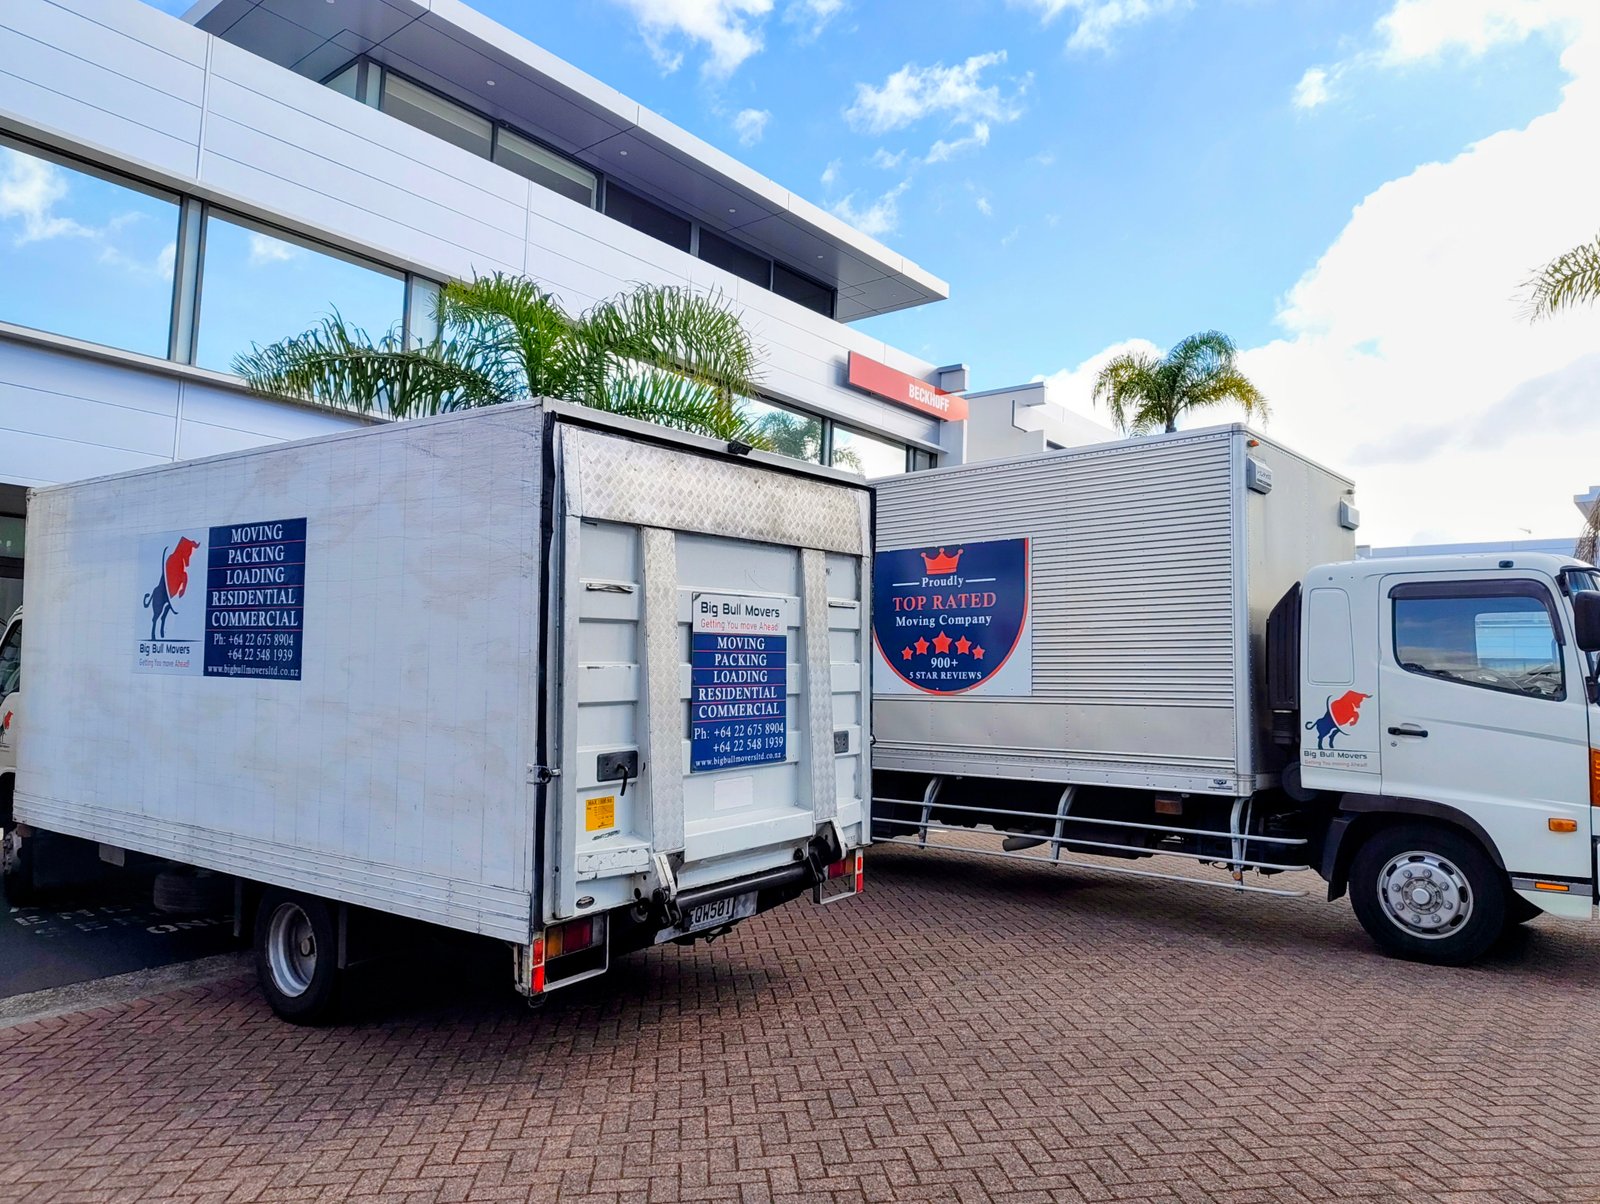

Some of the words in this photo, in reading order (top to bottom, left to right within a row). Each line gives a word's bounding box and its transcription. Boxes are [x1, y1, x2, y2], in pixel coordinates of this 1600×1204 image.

[909, 384, 950, 412] BECKHOFF
[231, 524, 283, 544] MOVING
[228, 545, 284, 564] PACKING
[226, 567, 285, 585] LOADING
[922, 575, 964, 588] Proudly
[212, 588, 296, 606] RESIDENTIAL
[892, 596, 927, 612] TOP
[933, 592, 996, 610] RATED
[701, 601, 718, 617] Big
[723, 603, 741, 615] Bull
[746, 605, 780, 618] Movers
[211, 610, 298, 627] COMMERCIAL
[701, 618, 725, 631] Getting
[727, 620, 738, 629] You
[740, 622, 757, 630] move
[896, 616, 936, 628] Moving
[939, 615, 992, 626] Company
[213, 633, 226, 645] Ph:
[228, 634, 243, 645] +64
[244, 634, 254, 645] 22
[257, 634, 271, 646] 675
[274, 634, 294, 646] 8904
[717, 637, 765, 650] MOVING
[140, 644, 150, 656] Big
[152, 644, 164, 653] Bull
[166, 644, 190, 654] Movers
[227, 649, 242, 660] +64
[243, 649, 254, 660] 22
[256, 649, 270, 661] 548
[273, 649, 292, 661] 1939
[715, 654, 767, 666] PACKING
[931, 657, 958, 669] 900+
[208, 664, 298, 677] www.bigbullmoversltd.co.nz
[713, 670, 768, 683] LOADING
[699, 686, 777, 701] RESIDENTIAL
[699, 702, 779, 718] COMMERCIAL
[694, 727, 709, 740] Ph:
[714, 725, 731, 738] +64
[734, 724, 744, 737] 22
[747, 723, 762, 736] 675
[765, 722, 784, 734] 8904
[713, 740, 730, 753] +64
[733, 740, 744, 752] 22
[747, 738, 762, 750] 548
[765, 736, 783, 749] 1939
[696, 752, 781, 767] www.bigbullmoversltd.co.nz
[1304, 750, 1317, 758] Big
